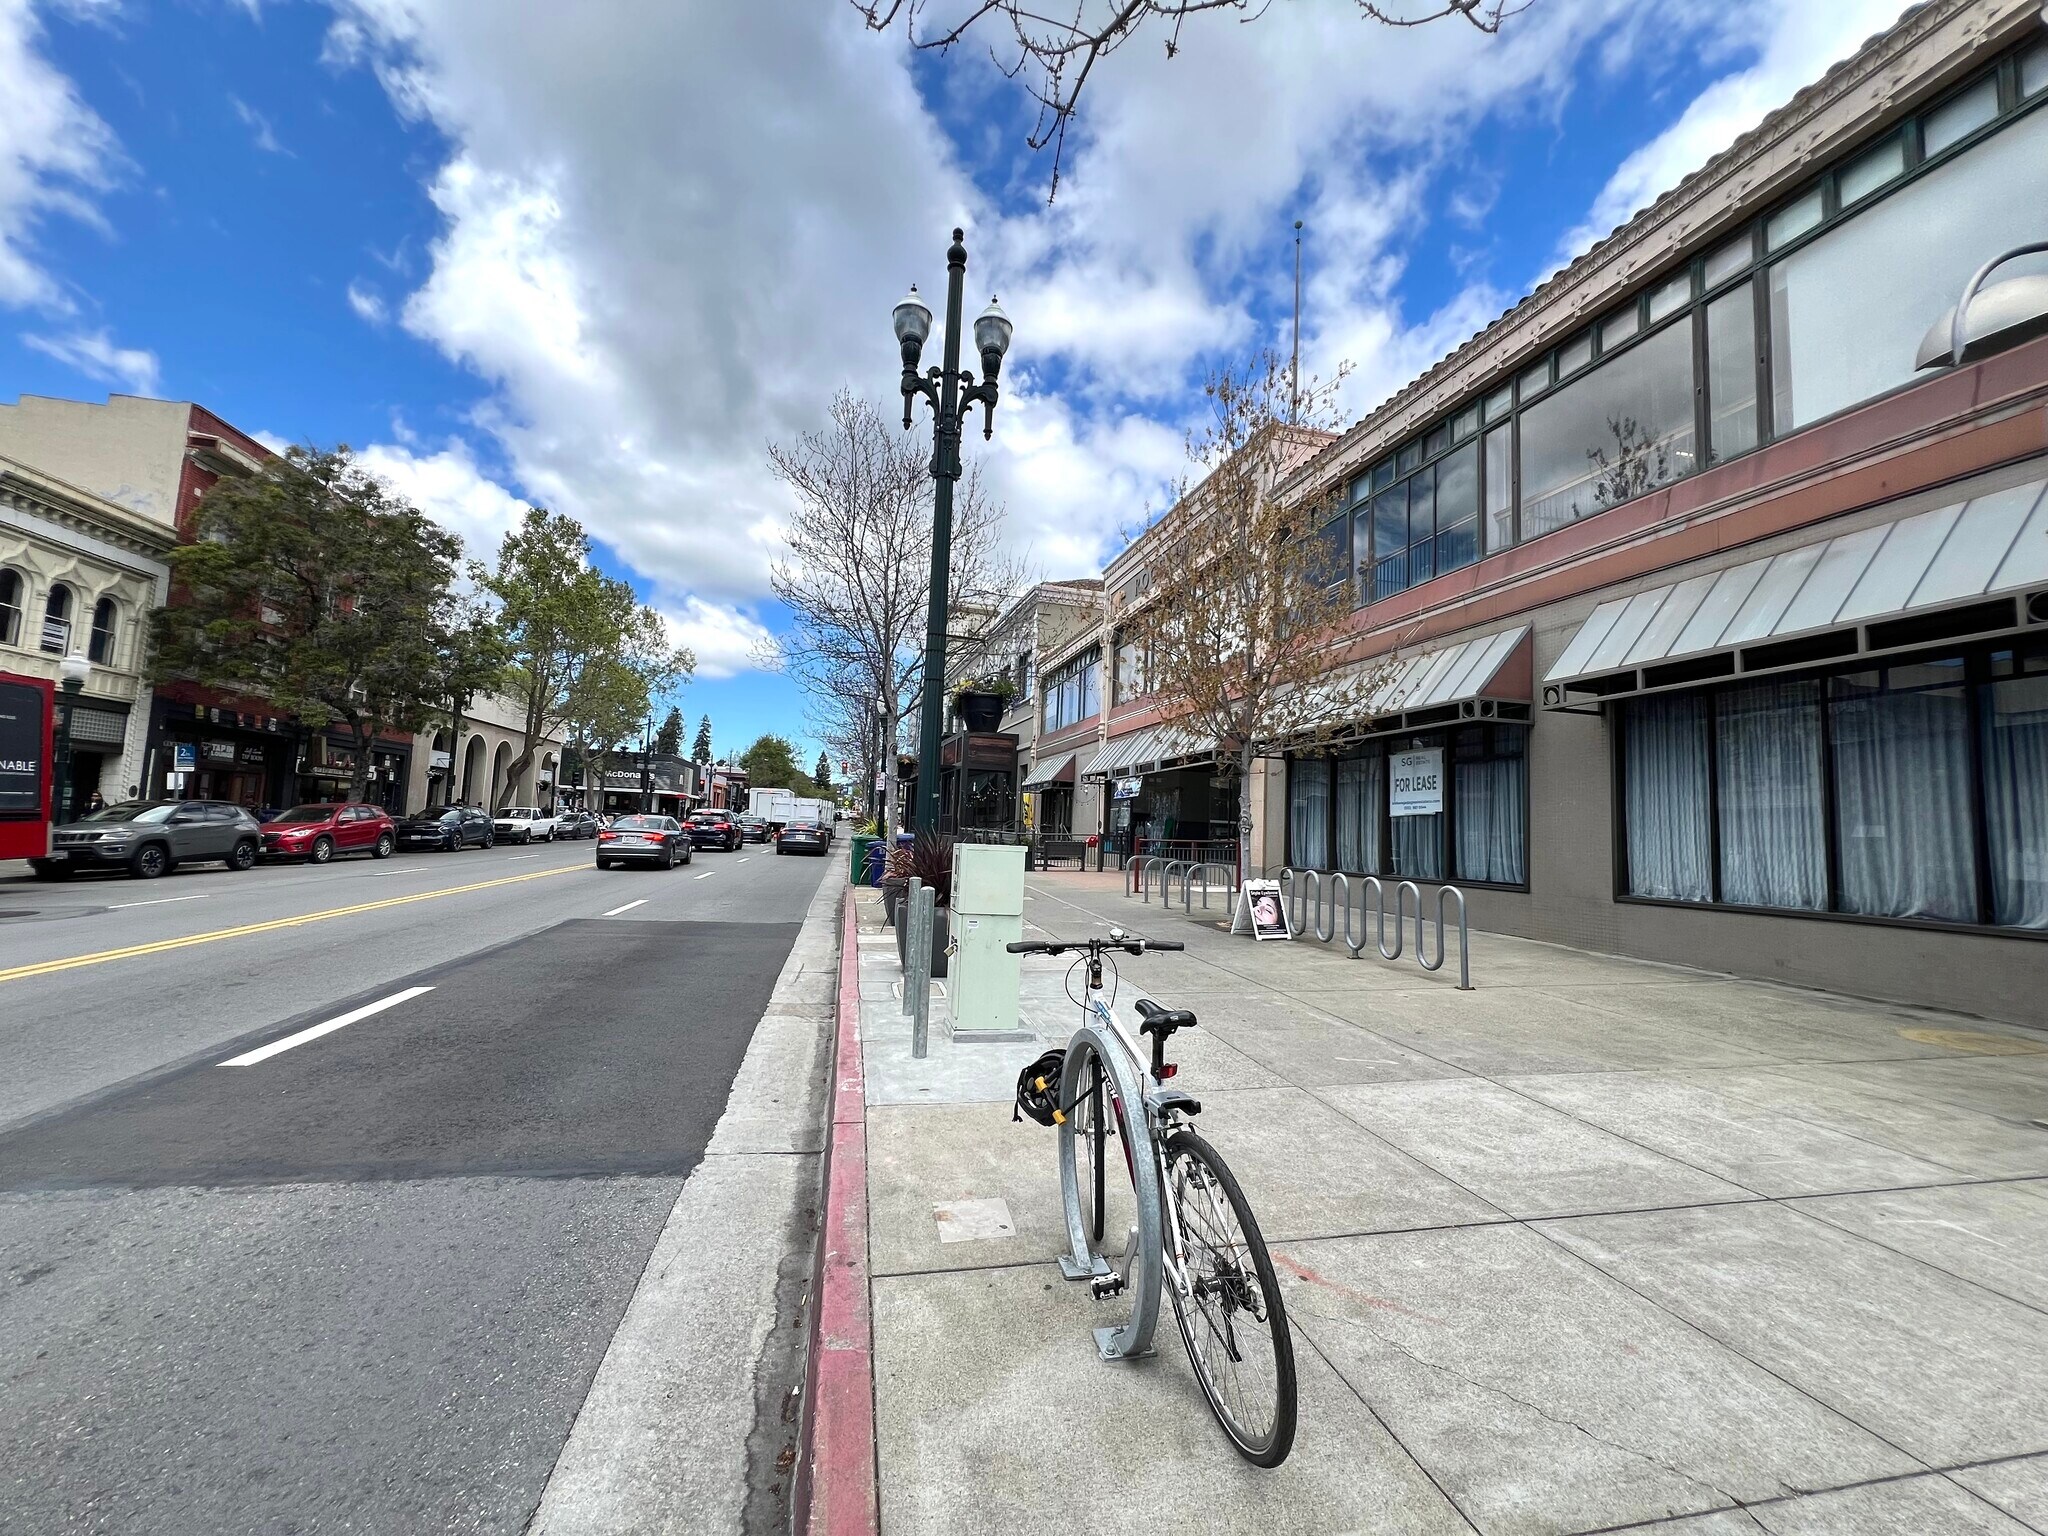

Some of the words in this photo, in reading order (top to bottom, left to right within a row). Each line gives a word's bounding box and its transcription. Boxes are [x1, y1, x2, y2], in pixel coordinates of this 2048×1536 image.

[1401, 757, 1413, 767] SG
[605, 770, 656, 780] McDona's
[1395, 778, 1410, 792] FOR
[1412, 775, 1437, 791] LEASE
